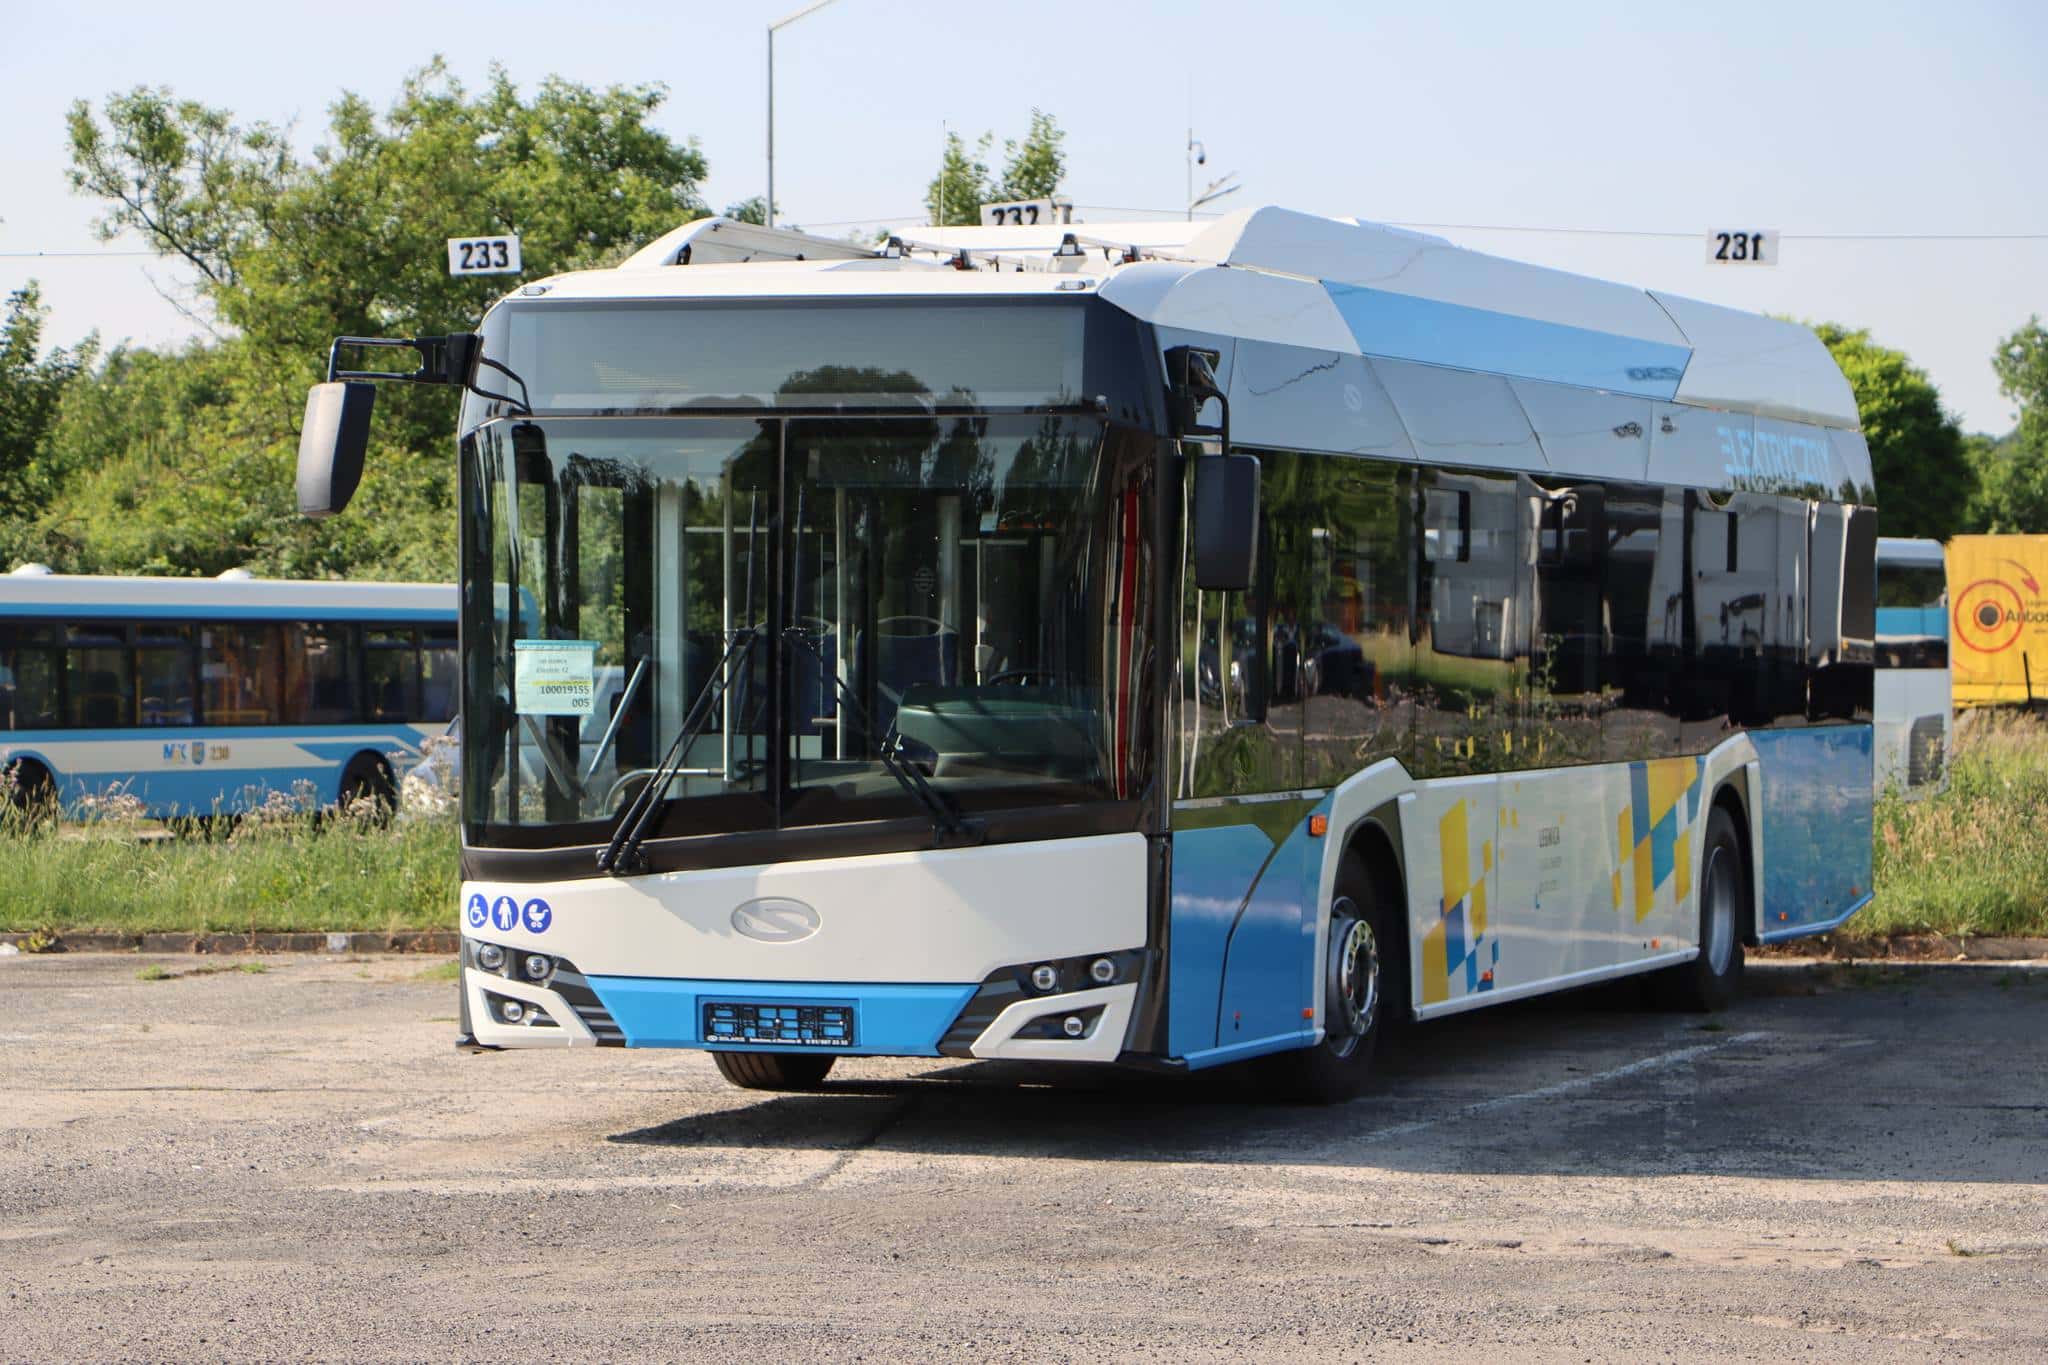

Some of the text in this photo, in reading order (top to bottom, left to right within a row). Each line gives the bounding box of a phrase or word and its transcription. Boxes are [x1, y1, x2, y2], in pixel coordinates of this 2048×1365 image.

[460, 241, 508, 269] 233
[1715, 232, 1762, 261] 231
[541, 686, 590, 695] 100019155
[572, 699, 590, 707] 005
